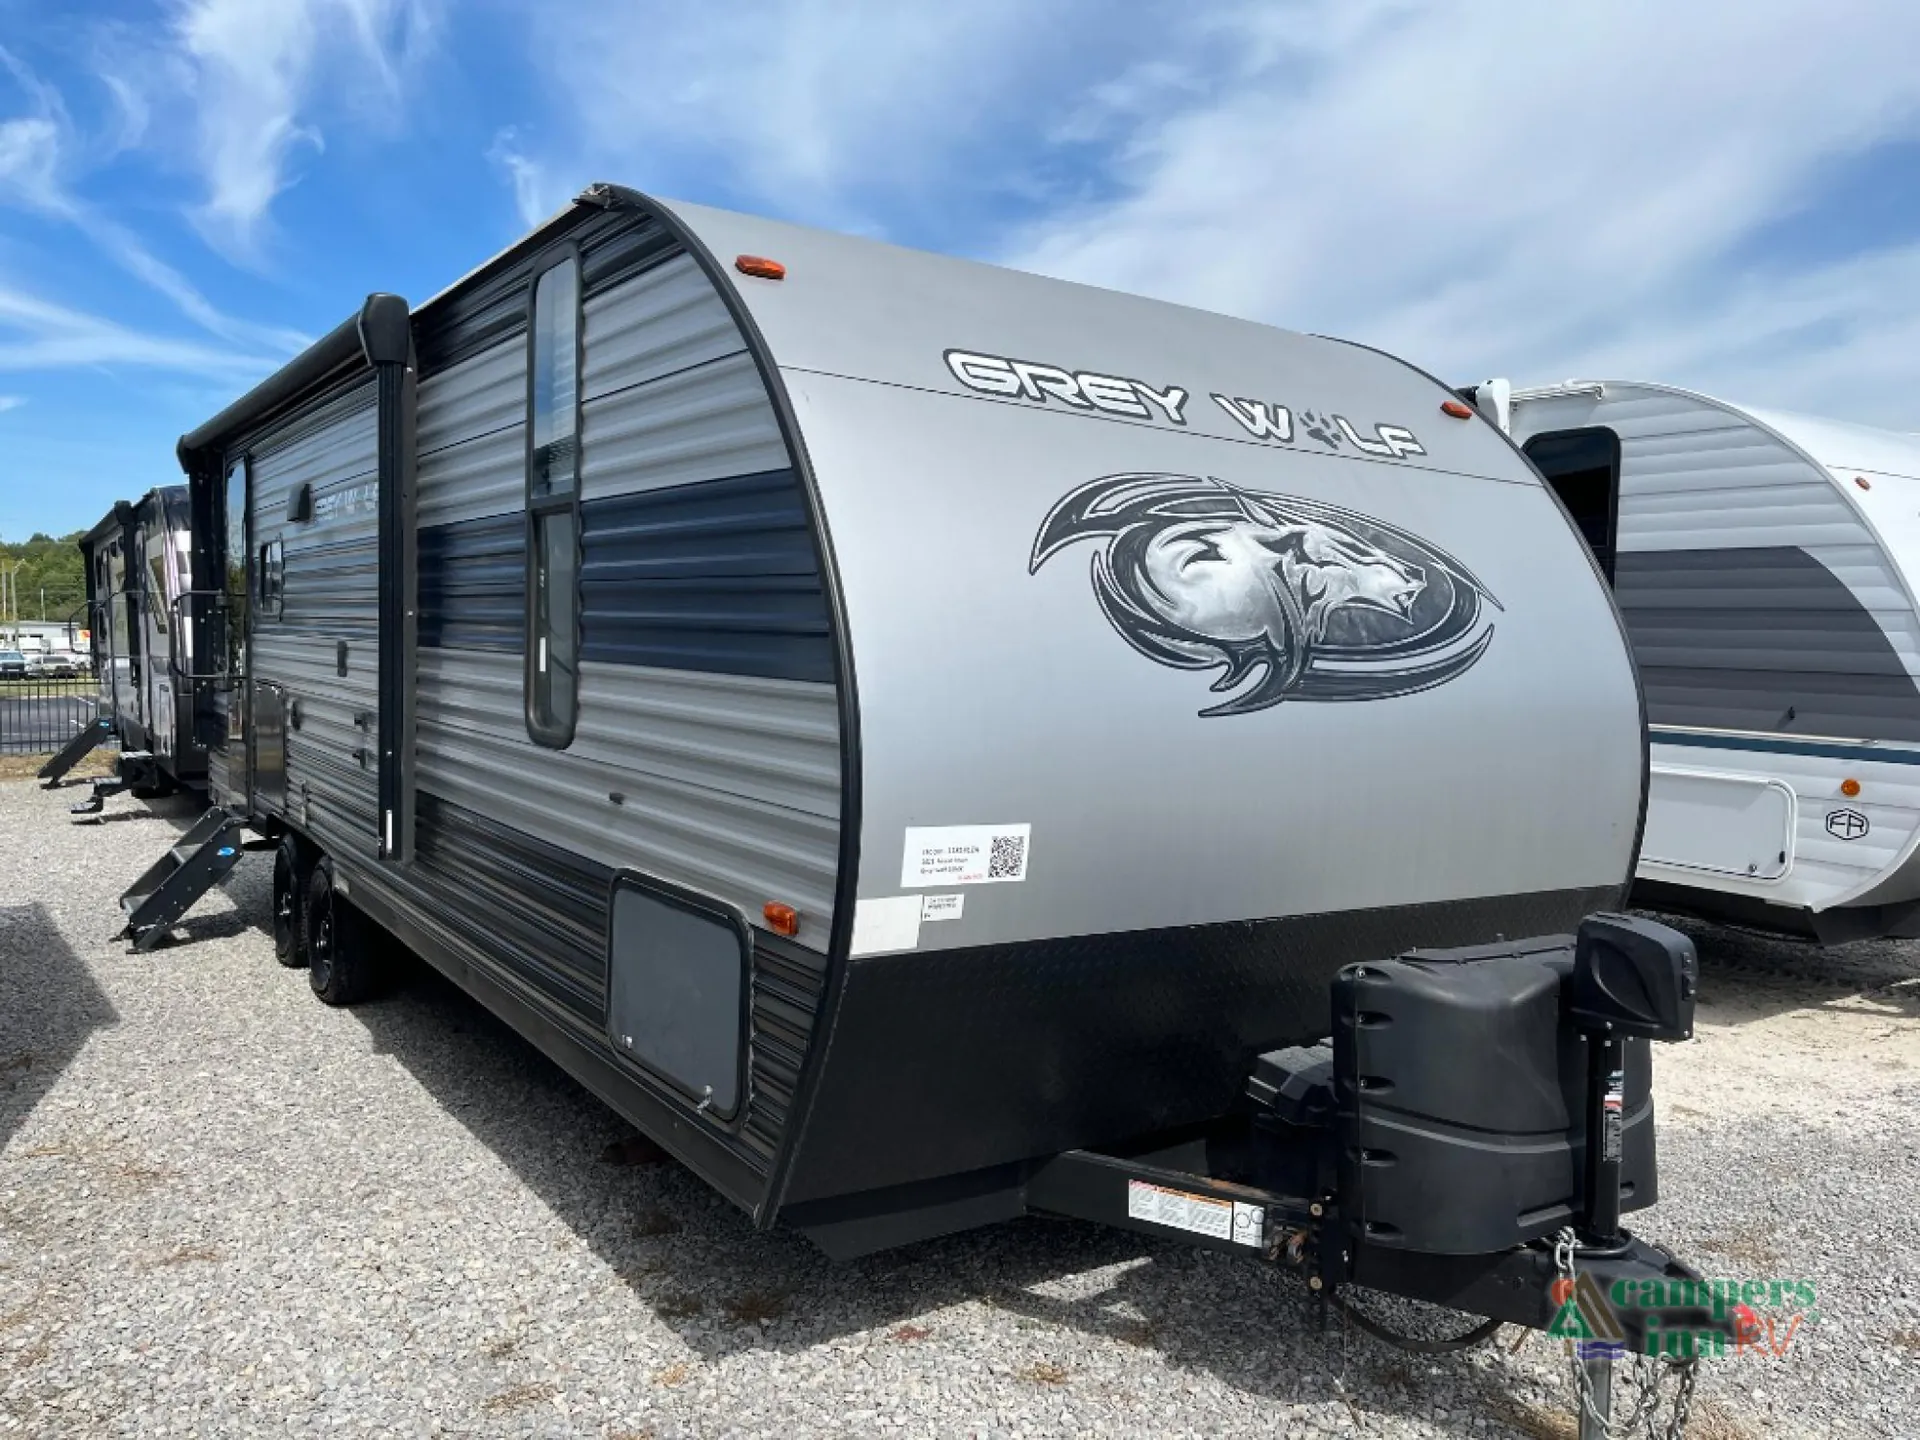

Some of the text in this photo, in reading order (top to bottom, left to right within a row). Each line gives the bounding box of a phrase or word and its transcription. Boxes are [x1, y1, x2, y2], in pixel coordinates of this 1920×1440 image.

[943, 348, 1427, 459] GREY WLF
[1829, 813, 1865, 837] FR
